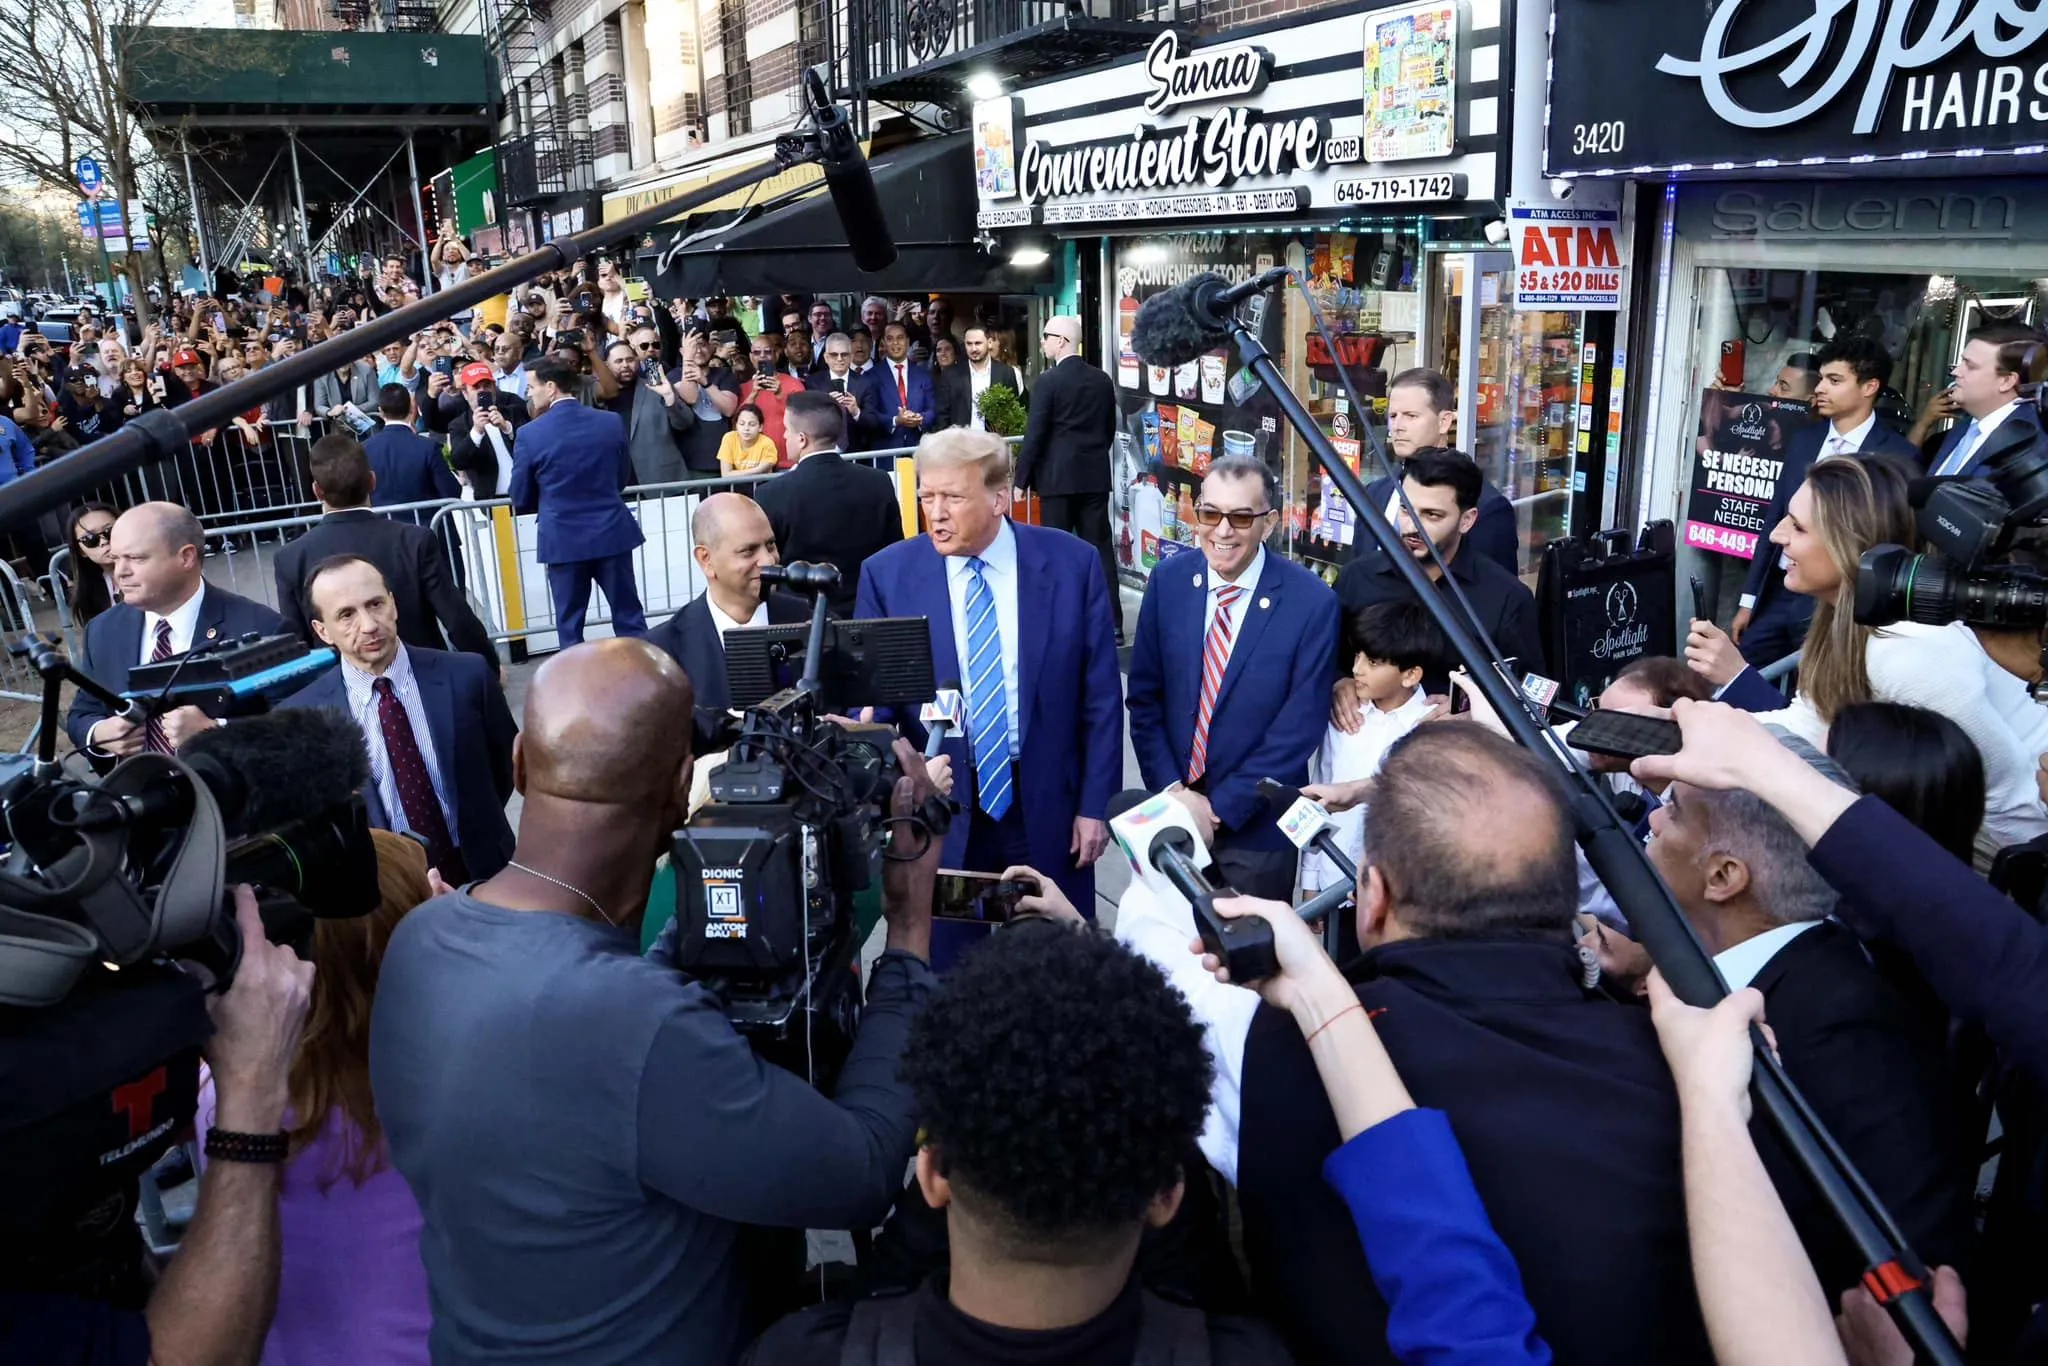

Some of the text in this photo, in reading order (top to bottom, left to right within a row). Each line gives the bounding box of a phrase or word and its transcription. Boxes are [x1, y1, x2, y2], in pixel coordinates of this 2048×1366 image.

[1148, 33, 1256, 110] Sanaa
[1573, 121, 1625, 155] 3420
[1019, 107, 1322, 205] Convenient Store
[1326, 140, 1359, 162] CORP.
[1336, 175, 1452, 203] 646-719-1742
[994, 209, 1030, 224] BROADWAY
[1063, 204, 1084, 220] GROCERY
[1089, 201, 1118, 219] BEVERAGES
[1121, 203, 1140, 217] CANDY
[1145, 203, 1171, 217] HOOKAH
[1173, 198, 1212, 215] ACCESSORIES
[1217, 197, 1230, 211] ATM
[1236, 195, 1247, 211] EBT
[1253, 193, 1273, 210] DEBIT
[1275, 191, 1294, 208] CARD
[1530, 210, 1549, 218] ATM
[1551, 210, 1580, 219] ACCESS
[1712, 185, 2016, 231] Salerm
[1521, 226, 1620, 267] ATM
[1520, 271, 1619, 291] $5 & $20 BILLS
[1702, 449, 1720, 469] SE
[1707, 470, 1775, 501] PERSONA
[1720, 497, 1760, 516] STAFF
[1589, 623, 1648, 658] Spotlight
[1627, 646, 1643, 657] SALON
[702, 868, 744, 879] DIONIC
[715, 892, 733, 905] XT
[705, 922, 747, 931] ANTON
